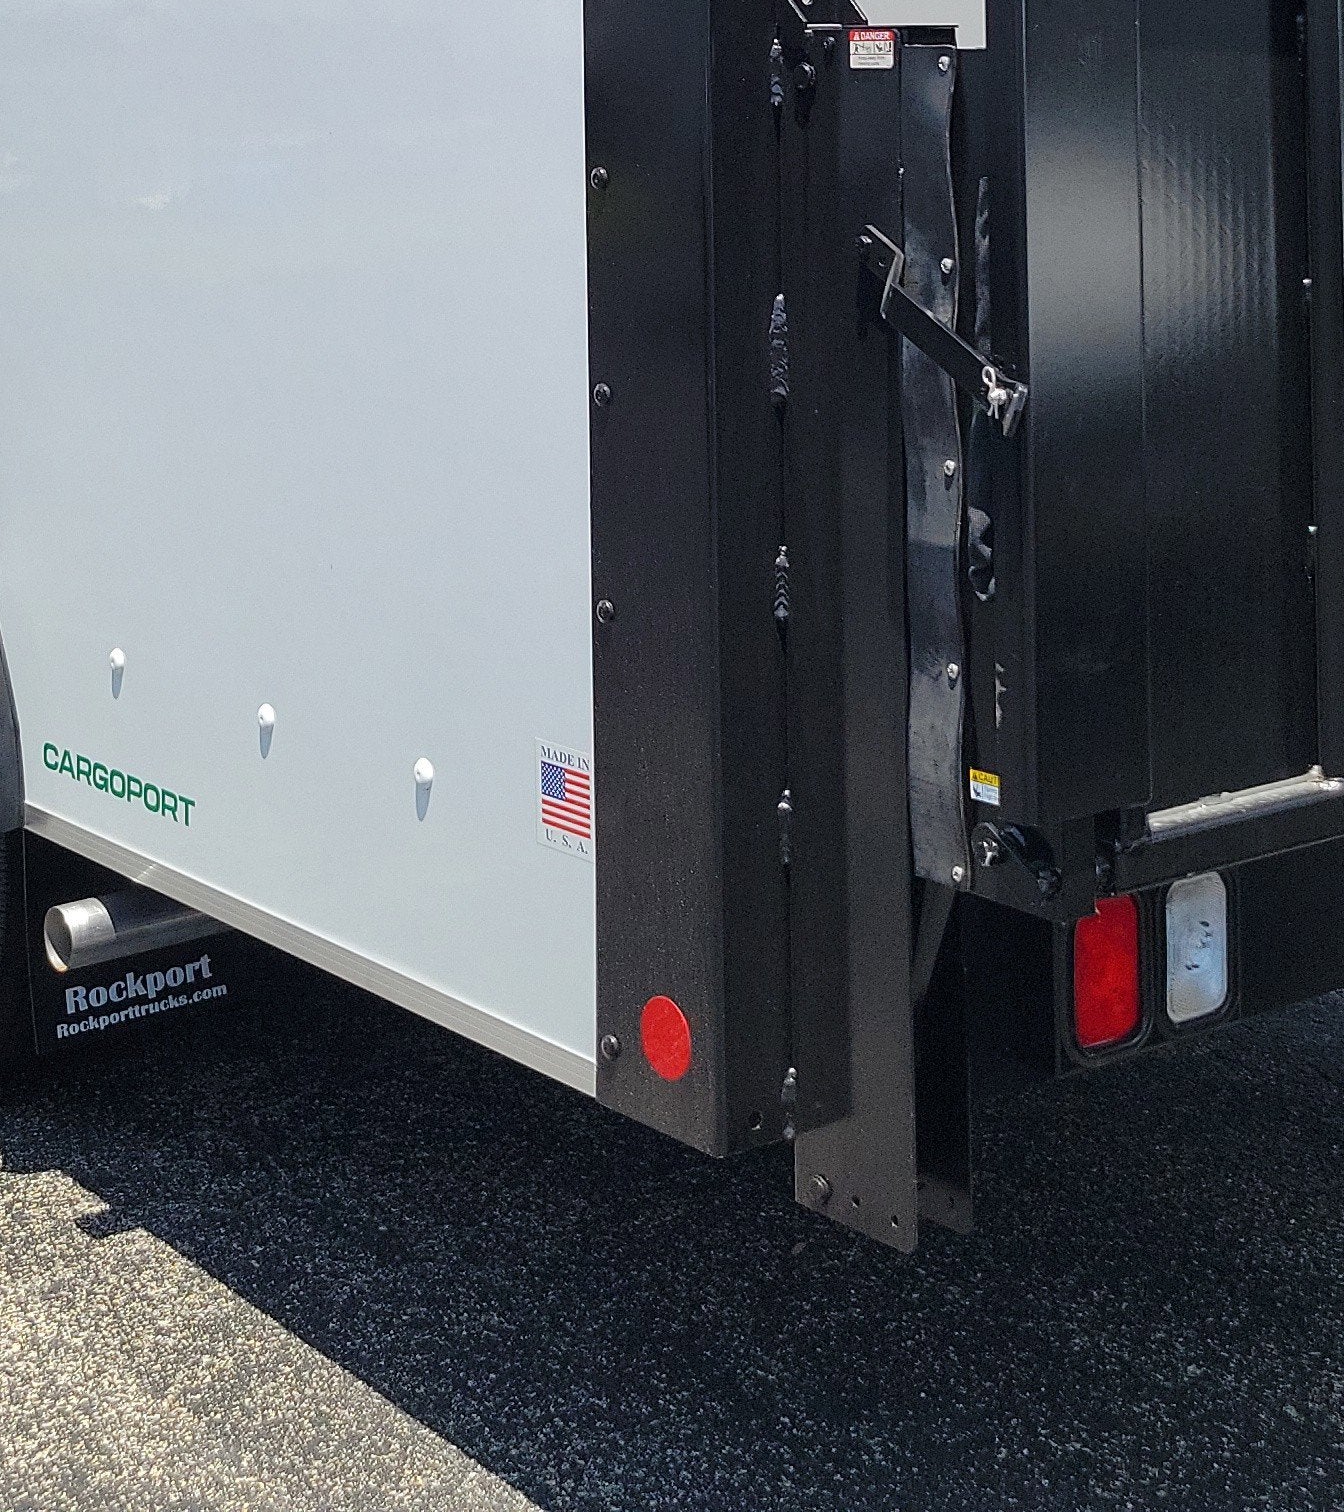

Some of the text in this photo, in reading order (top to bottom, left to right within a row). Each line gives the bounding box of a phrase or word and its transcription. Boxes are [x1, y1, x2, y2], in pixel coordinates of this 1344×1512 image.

[860, 31, 891, 41] DANGER
[42, 741, 196, 827] CARGOPORT
[540, 745, 590, 771] MADE IN
[56, 984, 228, 1039] Rockporttrucks.com
[65, 953, 213, 1016] Rockport
